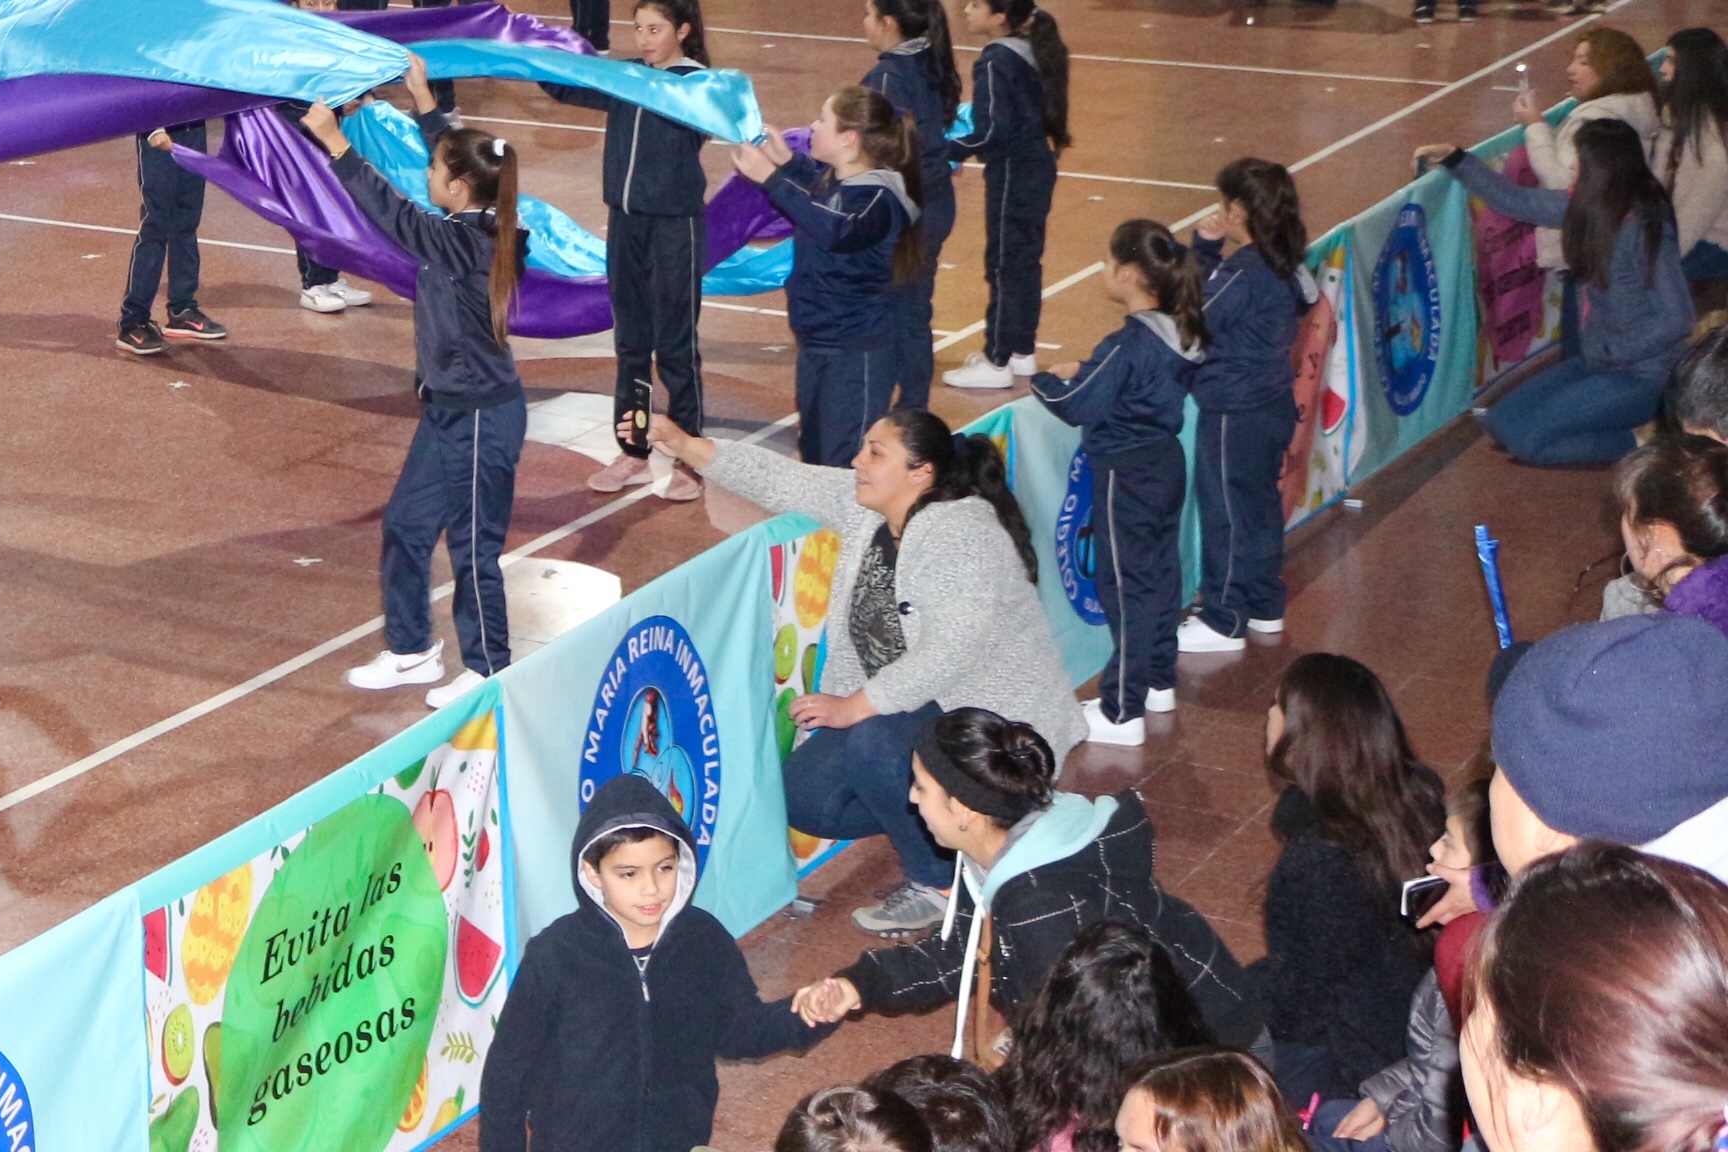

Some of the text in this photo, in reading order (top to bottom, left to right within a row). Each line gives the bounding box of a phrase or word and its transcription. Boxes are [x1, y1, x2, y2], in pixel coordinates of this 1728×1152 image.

[1056, 494, 1079, 600] COLEGIO
[584, 625, 720, 847] MARIA REINA INMACULADA
[259, 862, 402, 986] Evita las
[271, 934, 395, 1044] bebidas
[246, 997, 416, 1127] gaseosas
